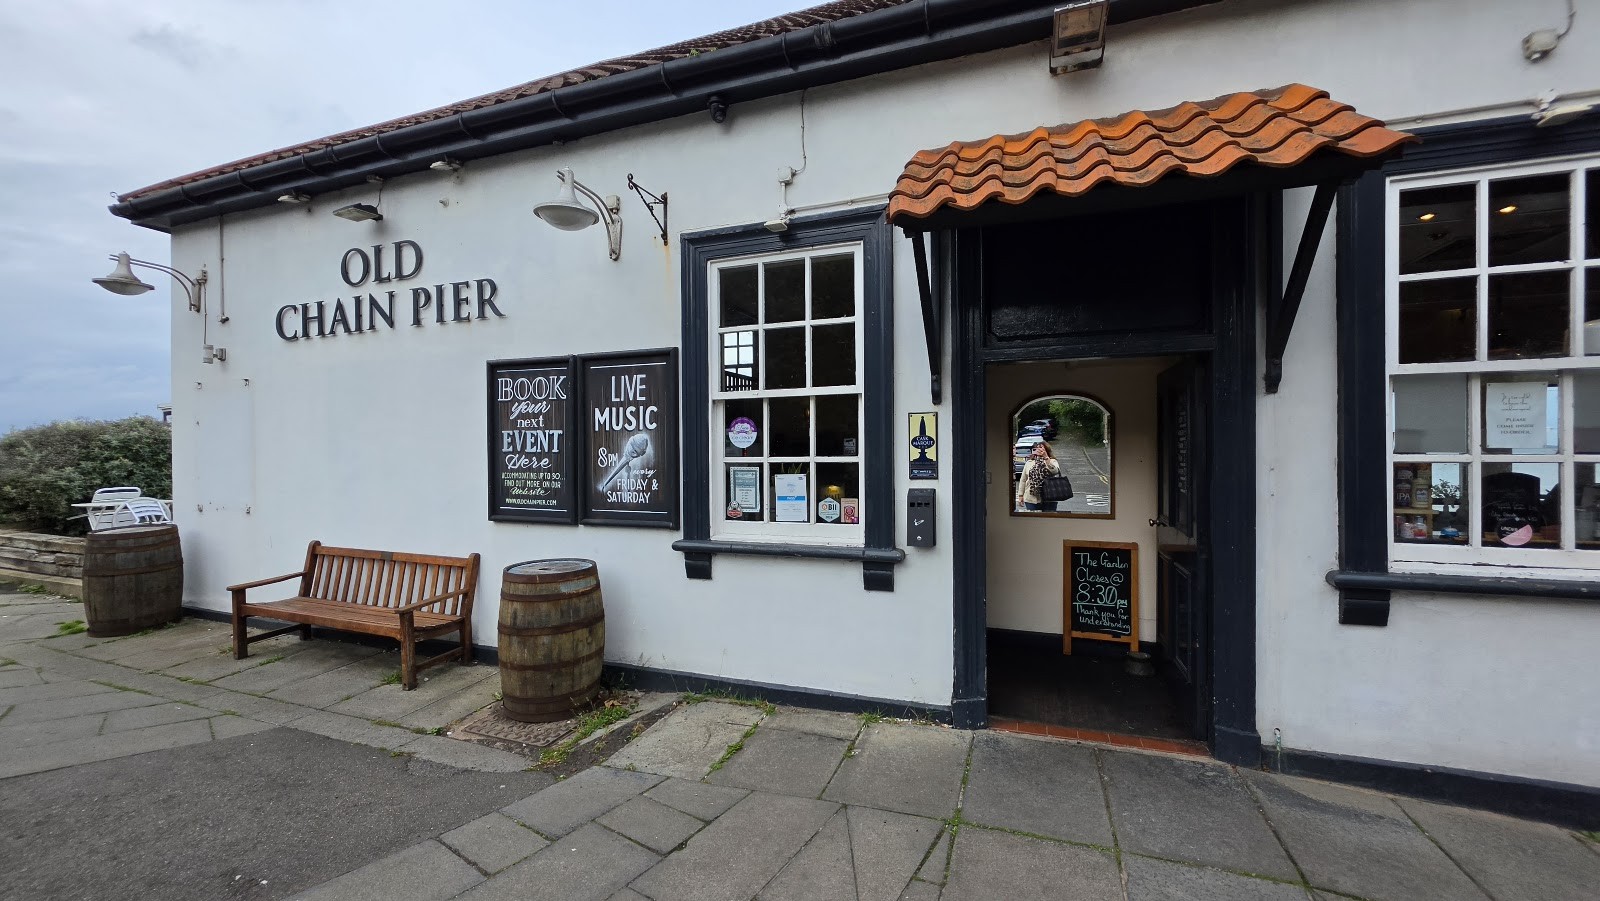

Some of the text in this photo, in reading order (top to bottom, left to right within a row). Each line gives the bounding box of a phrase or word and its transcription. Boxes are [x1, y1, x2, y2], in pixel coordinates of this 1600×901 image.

[340, 239, 424, 287] OLD
[275, 278, 506, 342] CHAIN PIER
[497, 375, 567, 401] BOOK
[611, 374, 647, 402] LIVE
[509, 401, 551, 420] your
[594, 405, 658, 432] MUSIC
[516, 414, 545, 428] next
[501, 429, 563, 453] EVENT
[505, 453, 552, 470] Here
[597, 447, 619, 468] 8PM
[501, 471, 538, 480] ACCOMMODATING
[538, 472, 544, 480] UP
[544, 472, 551, 480] TO
[632, 468, 657, 478] every
[504, 479, 515, 487] FIND
[515, 480, 525, 488] OUT
[526, 480, 540, 488] MORE
[551, 481, 562, 489] OUR
[509, 486, 551, 496] Website
[616, 478, 659, 491] FRIDAY &
[606, 490, 651, 504] SATURDAY
[1396, 492, 1411, 501] IPA
[1074, 551, 1129, 569] The Garden
[1076, 566, 1124, 586] Closes @
[1075, 602, 1129, 622] Thank you for
[1079, 615, 1130, 633] understanding
